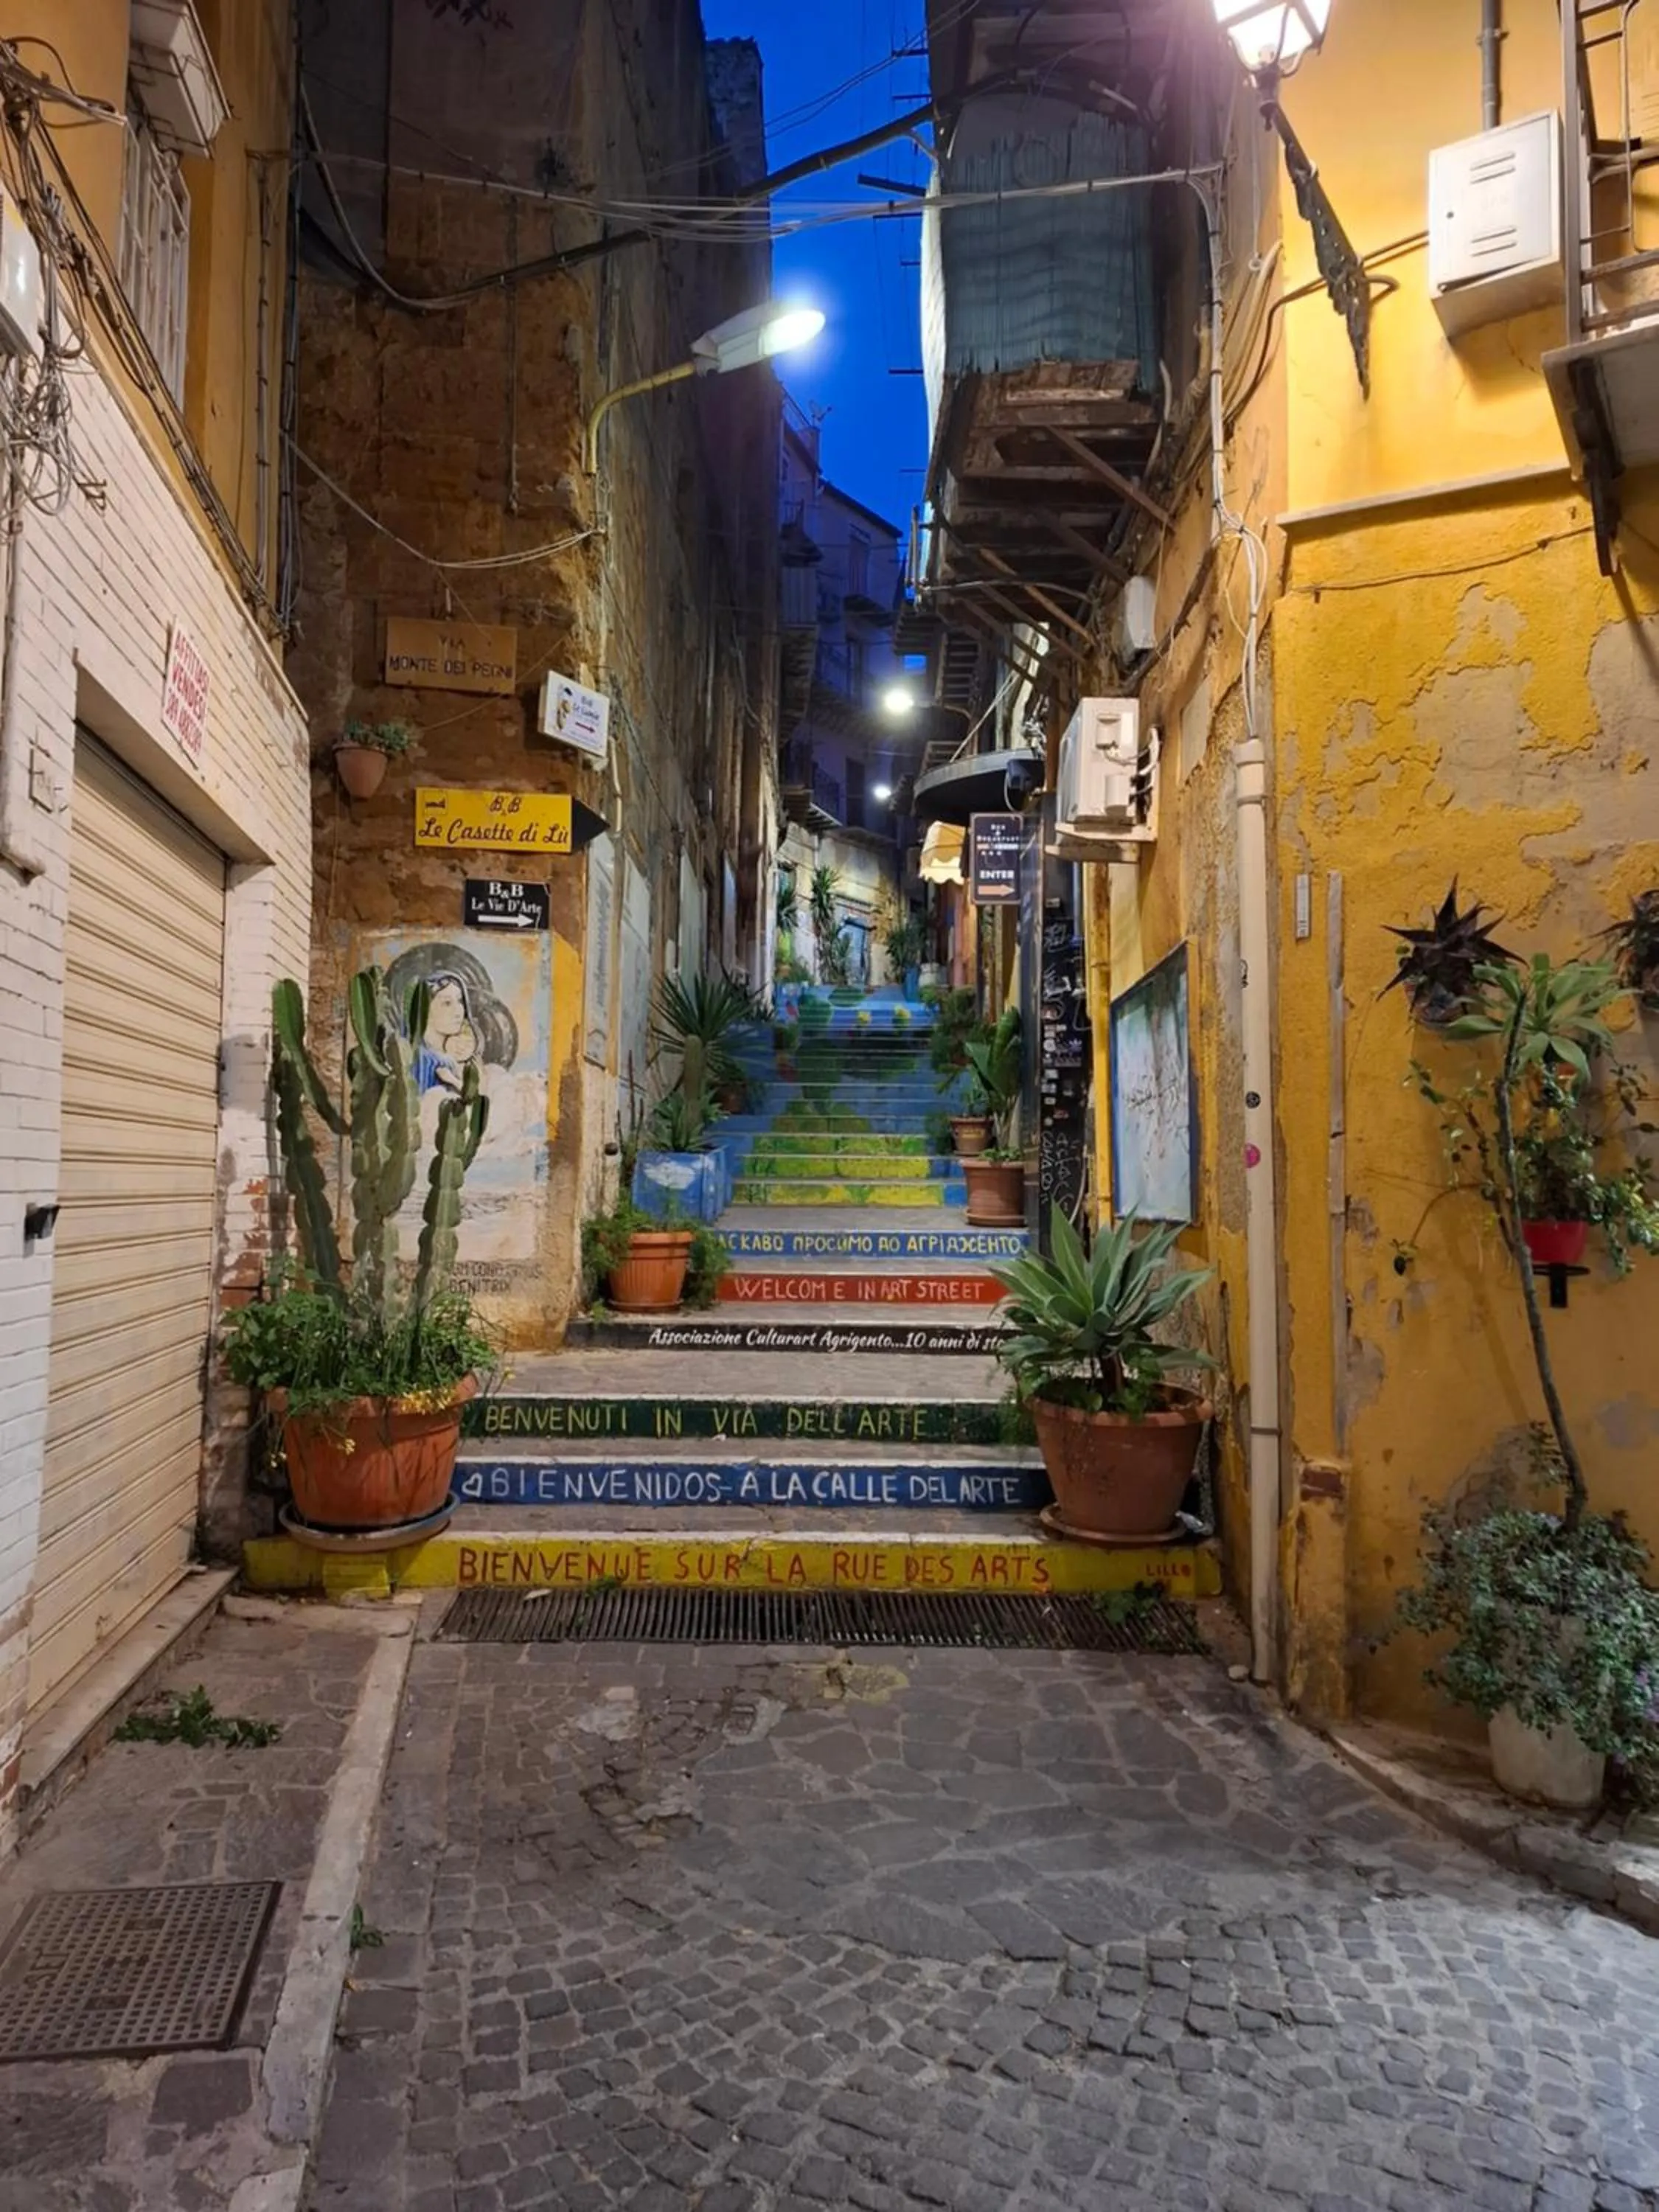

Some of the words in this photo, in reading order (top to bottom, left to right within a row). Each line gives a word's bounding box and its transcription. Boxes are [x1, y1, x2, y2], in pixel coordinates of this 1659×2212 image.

[438, 633, 466, 650] VIA
[389, 655, 438, 672] MONTE
[444, 660, 466, 675] DEI
[418, 817, 442, 838] Le
[446, 818, 515, 844] Casette
[518, 821, 539, 844] di
[542, 823, 569, 845] Lù
[979, 869, 1015, 880] ENTER
[489, 881, 524, 900] B&B
[471, 897, 485, 911] Le
[487, 898, 505, 912] Vie
[507, 897, 543, 915] D'Arte
[715, 1234, 785, 1252] АСКАВО
[734, 1276, 846, 1300] WELCOME
[858, 1279, 877, 1300] IN
[880, 1279, 912, 1300] ART
[915, 1280, 985, 1301] STREET
[647, 1327, 742, 1346] Associazione
[746, 1327, 817, 1346] Culturart
[928, 1333, 964, 1349] anni
[966, 1331, 982, 1350] di
[484, 1403, 627, 1433] BENVENUTI
[654, 1407, 682, 1438] IN
[712, 1406, 758, 1436] VIA
[740, 1471, 759, 1498] A
[771, 1471, 807, 1500] LA
[812, 1470, 898, 1503] CALLE
[909, 1475, 956, 1504] DEL
[960, 1475, 1022, 1504] ARTE
[458, 1546, 652, 1583] BIENVENUE
[672, 1550, 742, 1581] SUR
[765, 1552, 807, 1585] LA
[832, 1550, 886, 1583] RUE
[904, 1554, 955, 1585] DES
[970, 1554, 1051, 1584] ARTS
